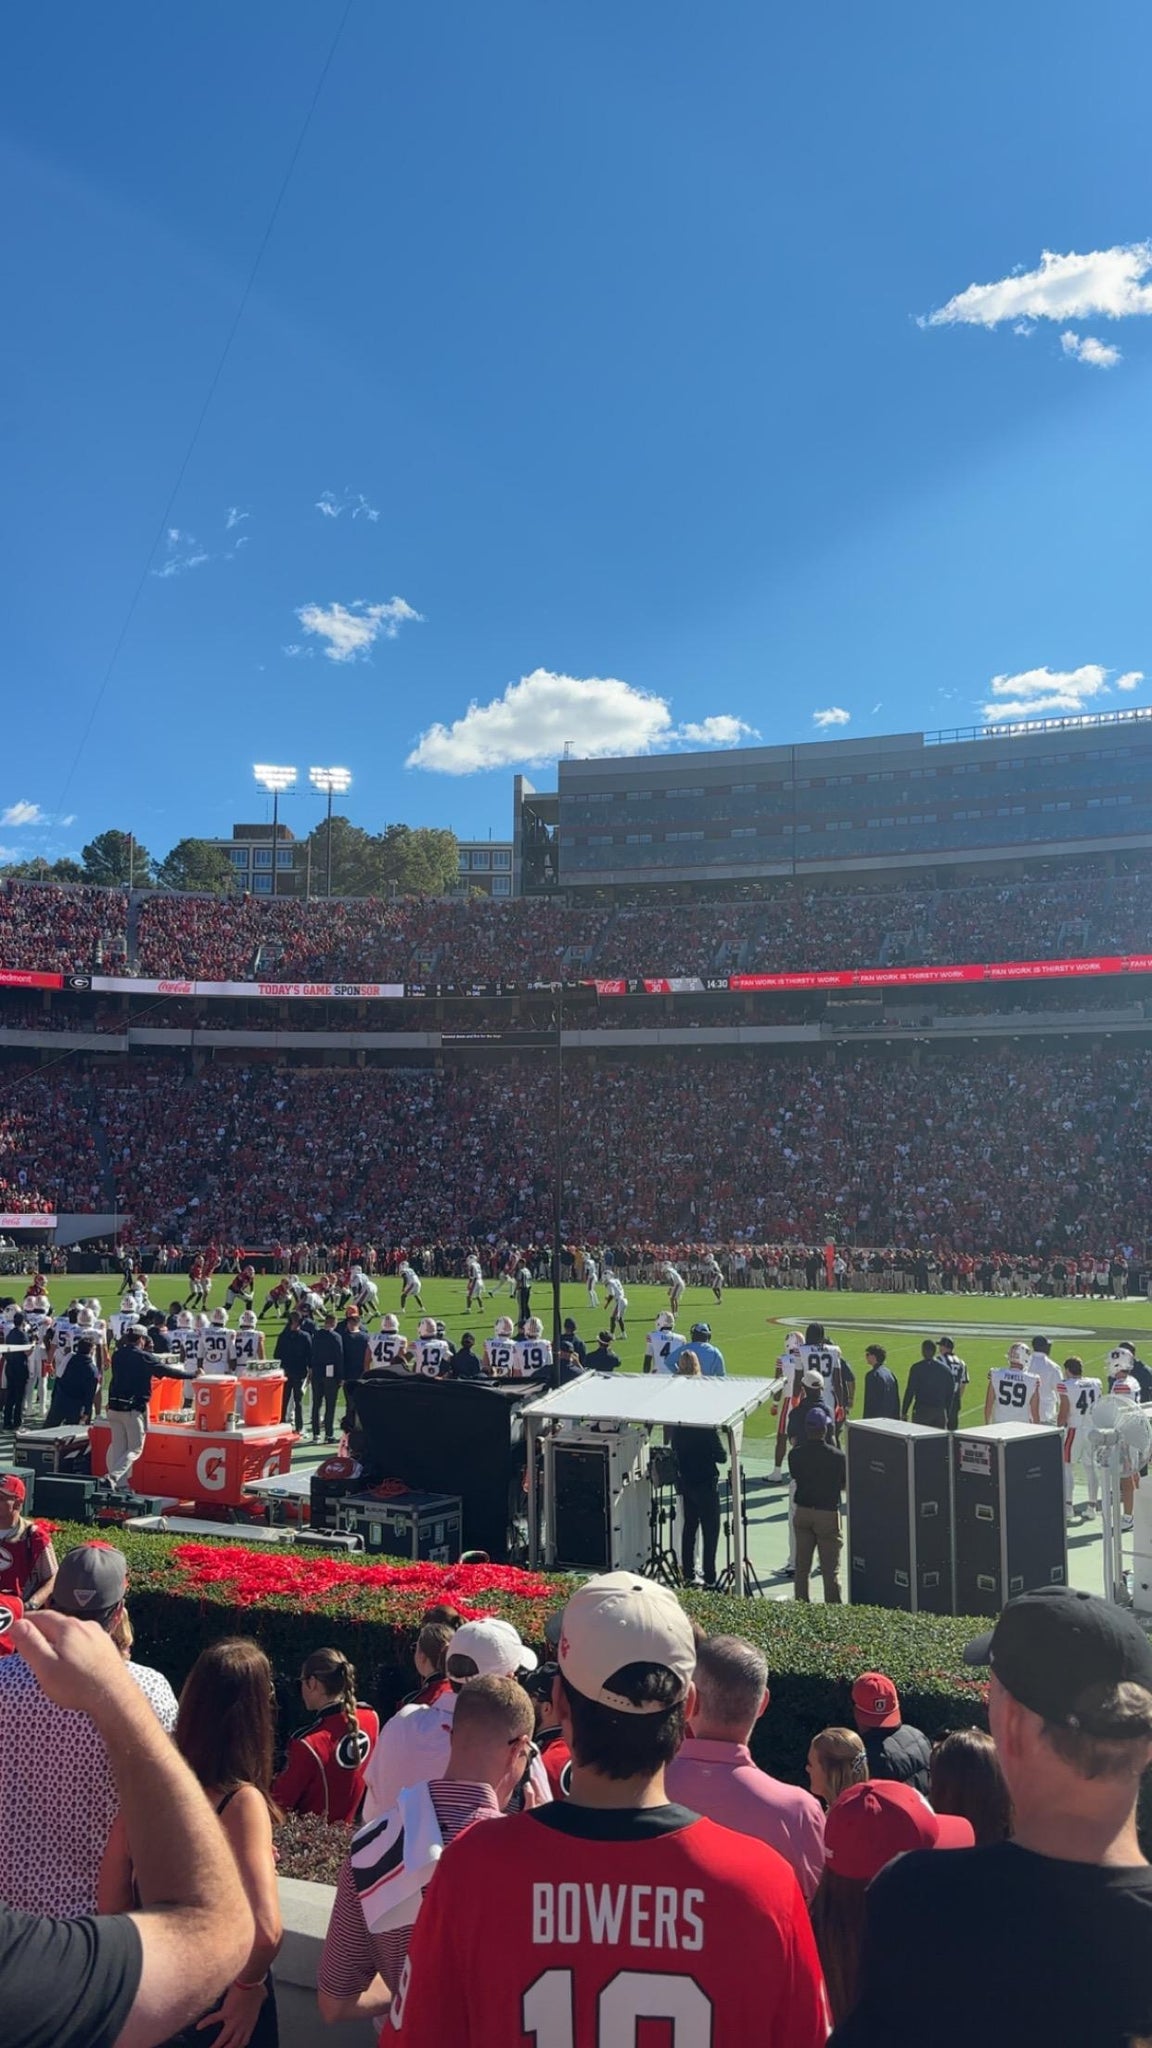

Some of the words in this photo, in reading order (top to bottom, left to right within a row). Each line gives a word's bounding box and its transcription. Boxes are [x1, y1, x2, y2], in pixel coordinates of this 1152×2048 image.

[860, 974, 874, 982] FAN
[907, 972, 939, 980] THIRSTY
[940, 970, 964, 978] WORK
[1042, 964, 1075, 972] THIRSTY
[707, 980, 728, 989] 14:30
[785, 977, 815, 985] THIRSTY
[817, 976, 840, 984] WORK
[258, 984, 300, 995] TODAY'S
[303, 985, 331, 995] GAME
[334, 985, 380, 996] SPONSOR
[205, 1337, 227, 1350] 30
[235, 1338, 254, 1357] 54
[374, 1342, 395, 1362] 45
[660, 1341, 671, 1357] 4
[422, 1348, 441, 1366] 13
[491, 1349, 510, 1367] 12
[523, 1348, 543, 1369] 19
[198, 1388, 210, 1406] G
[244, 1387, 258, 1406] G
[998, 1381, 1027, 1407] 59
[196, 1447, 226, 1491] G
[532, 1882, 705, 1951] BOWERS
